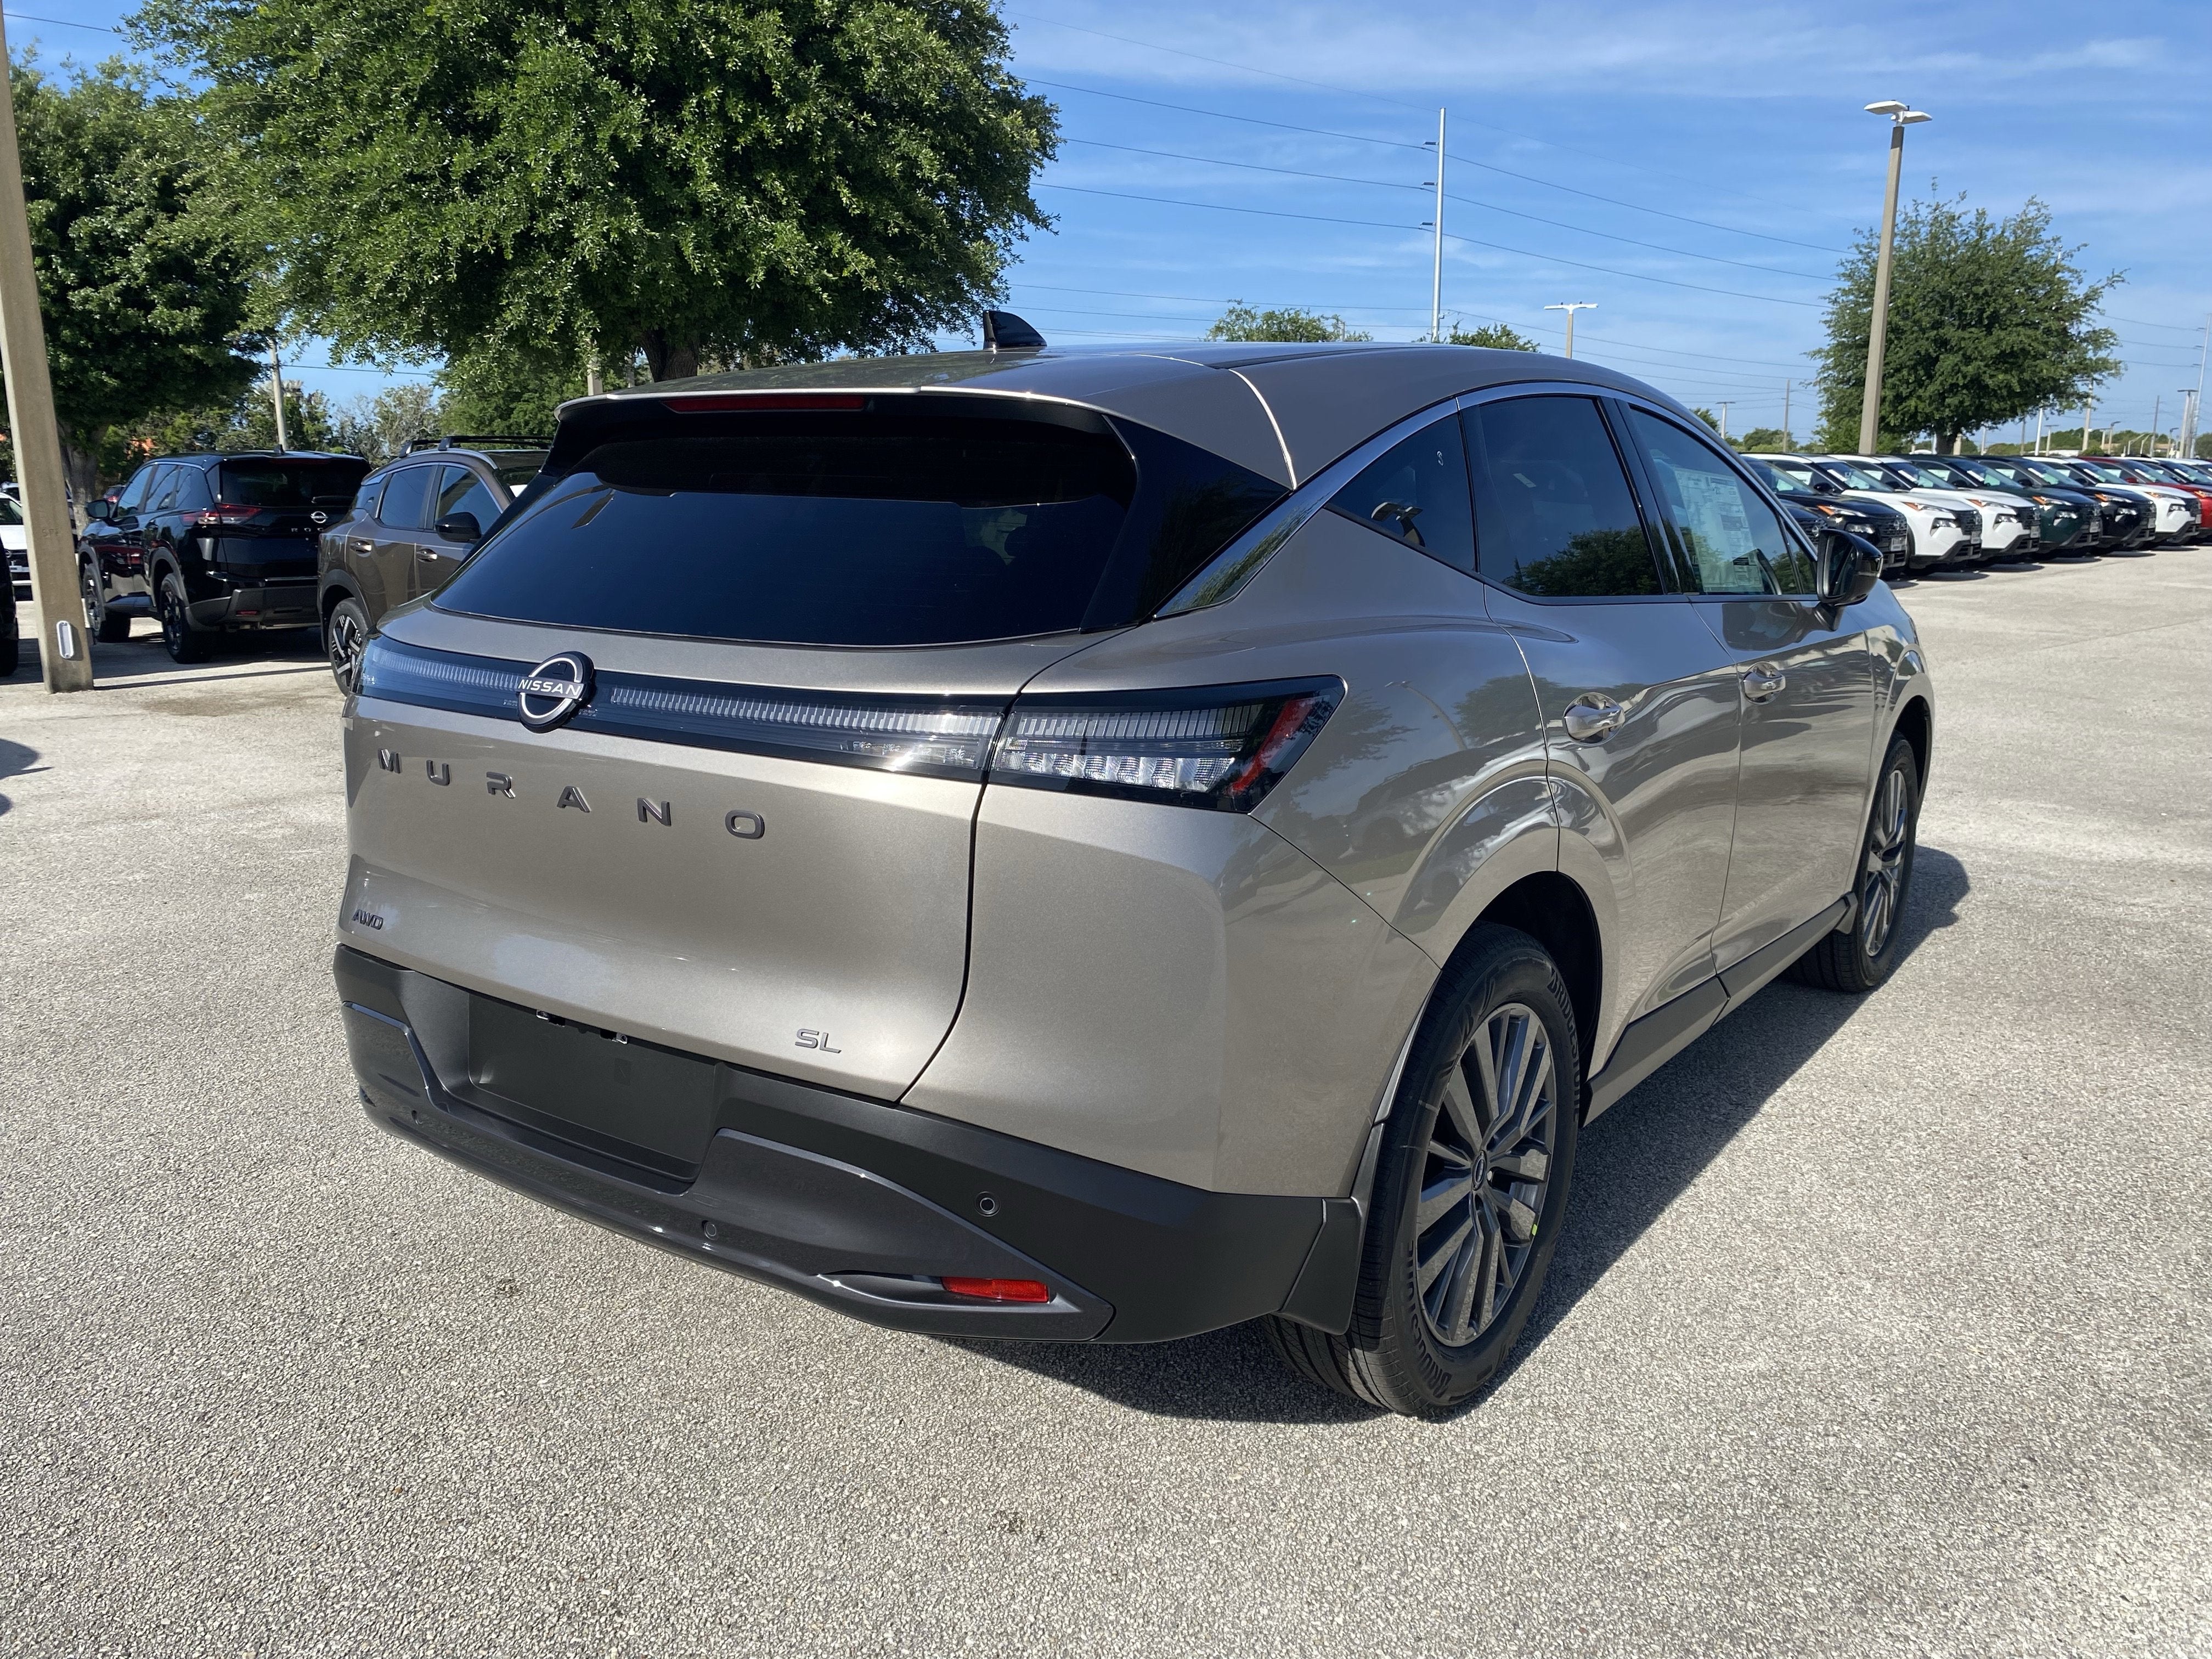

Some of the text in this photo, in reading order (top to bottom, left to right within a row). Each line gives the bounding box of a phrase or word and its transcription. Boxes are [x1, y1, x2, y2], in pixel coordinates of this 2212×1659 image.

[518, 679, 582, 696] NISSAN
[377, 747, 765, 839] MURANO
[351, 909, 383, 930] AWD
[794, 1028, 842, 1054] SL
[1547, 966, 1579, 1122] BRIDGESTONE
